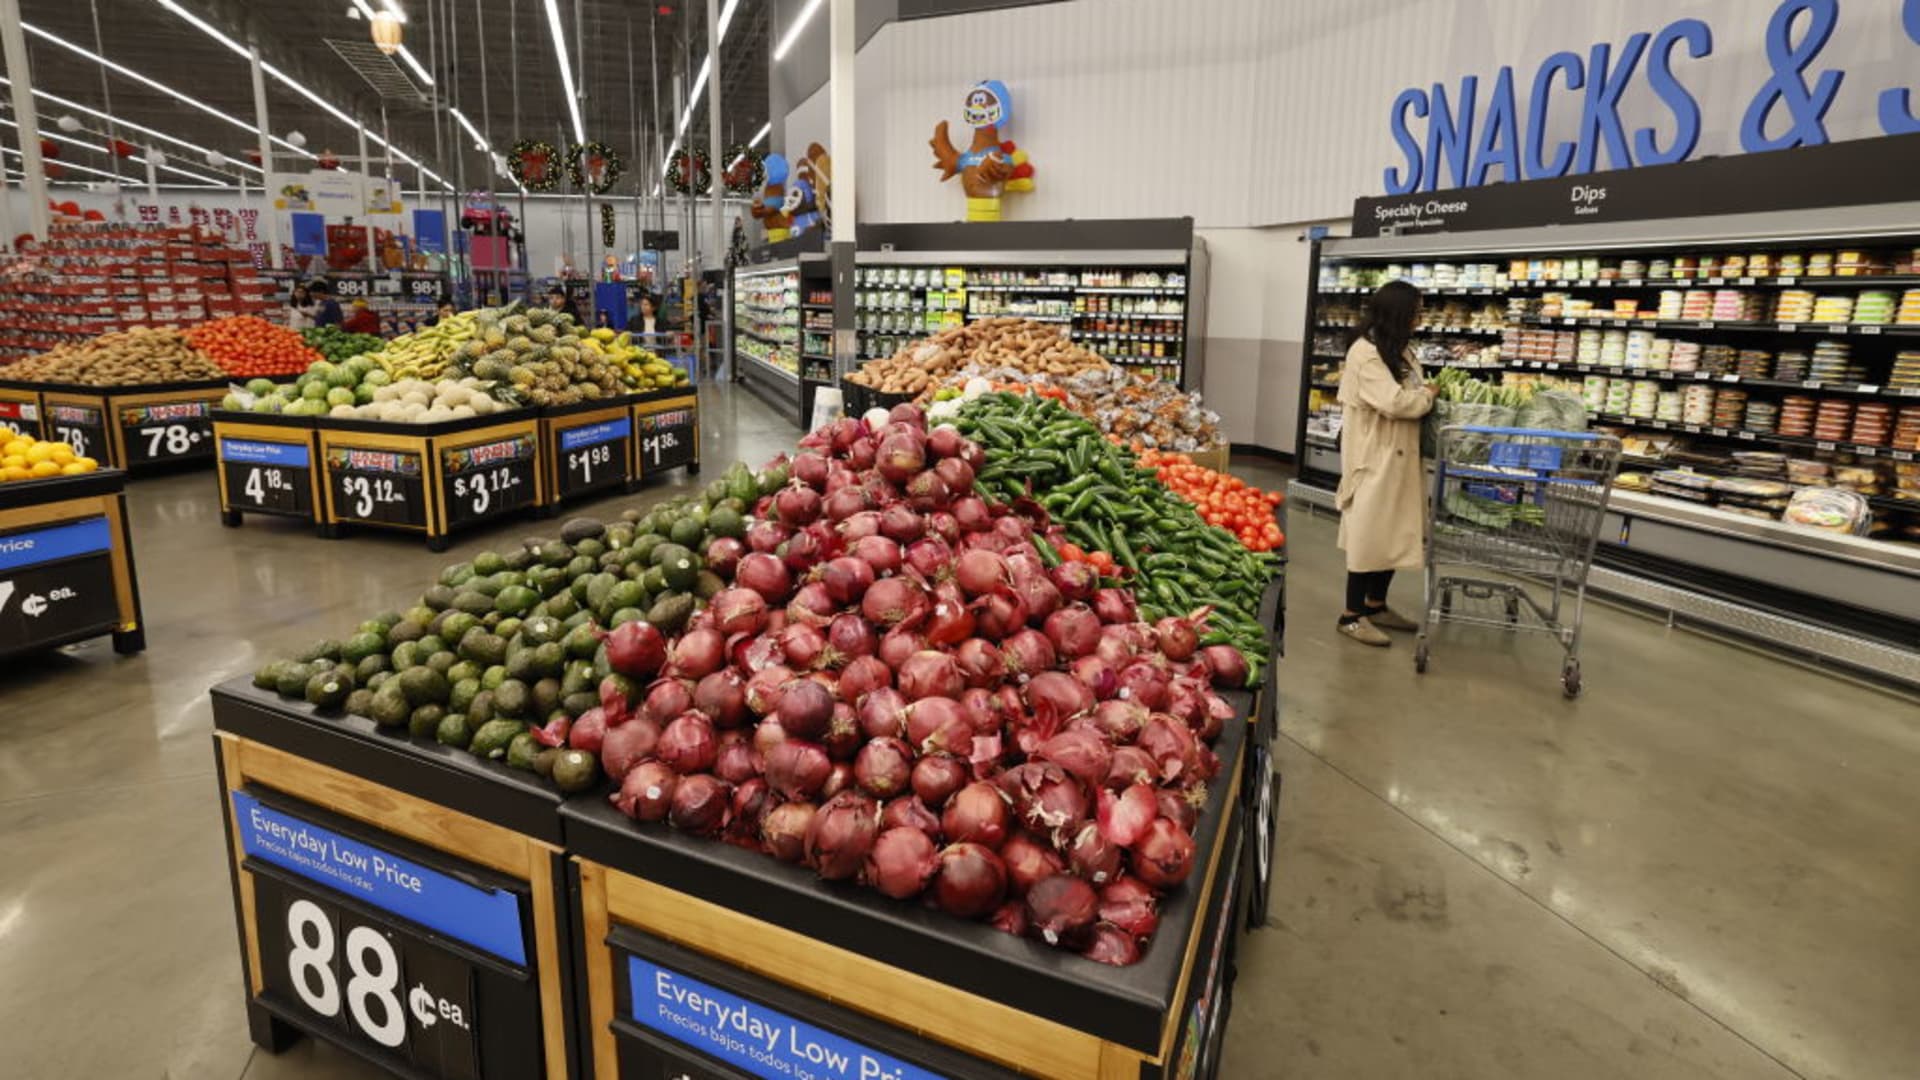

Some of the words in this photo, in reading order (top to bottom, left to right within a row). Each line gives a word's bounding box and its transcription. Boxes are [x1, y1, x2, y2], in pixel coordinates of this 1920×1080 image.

[1384, 18, 1713, 196] SNACKS
[1739, 0, 1846, 153] &
[1374, 203, 1423, 222] Specialty
[1425, 200, 1468, 215] Cheese
[1571, 185, 1606, 205] Dips
[0, 539, 35, 553] rice
[250, 808, 328, 862] Everyday
[331, 839, 368, 871] Low
[372, 855, 422, 894] Price
[437, 997, 471, 1030] ea.
[655, 971, 781, 1052] Everyday
[790, 1025, 849, 1074] Low
[659, 1003, 708, 1037] Precios
[709, 1026, 746, 1055] bajos
[748, 1047, 791, 1073] todos
